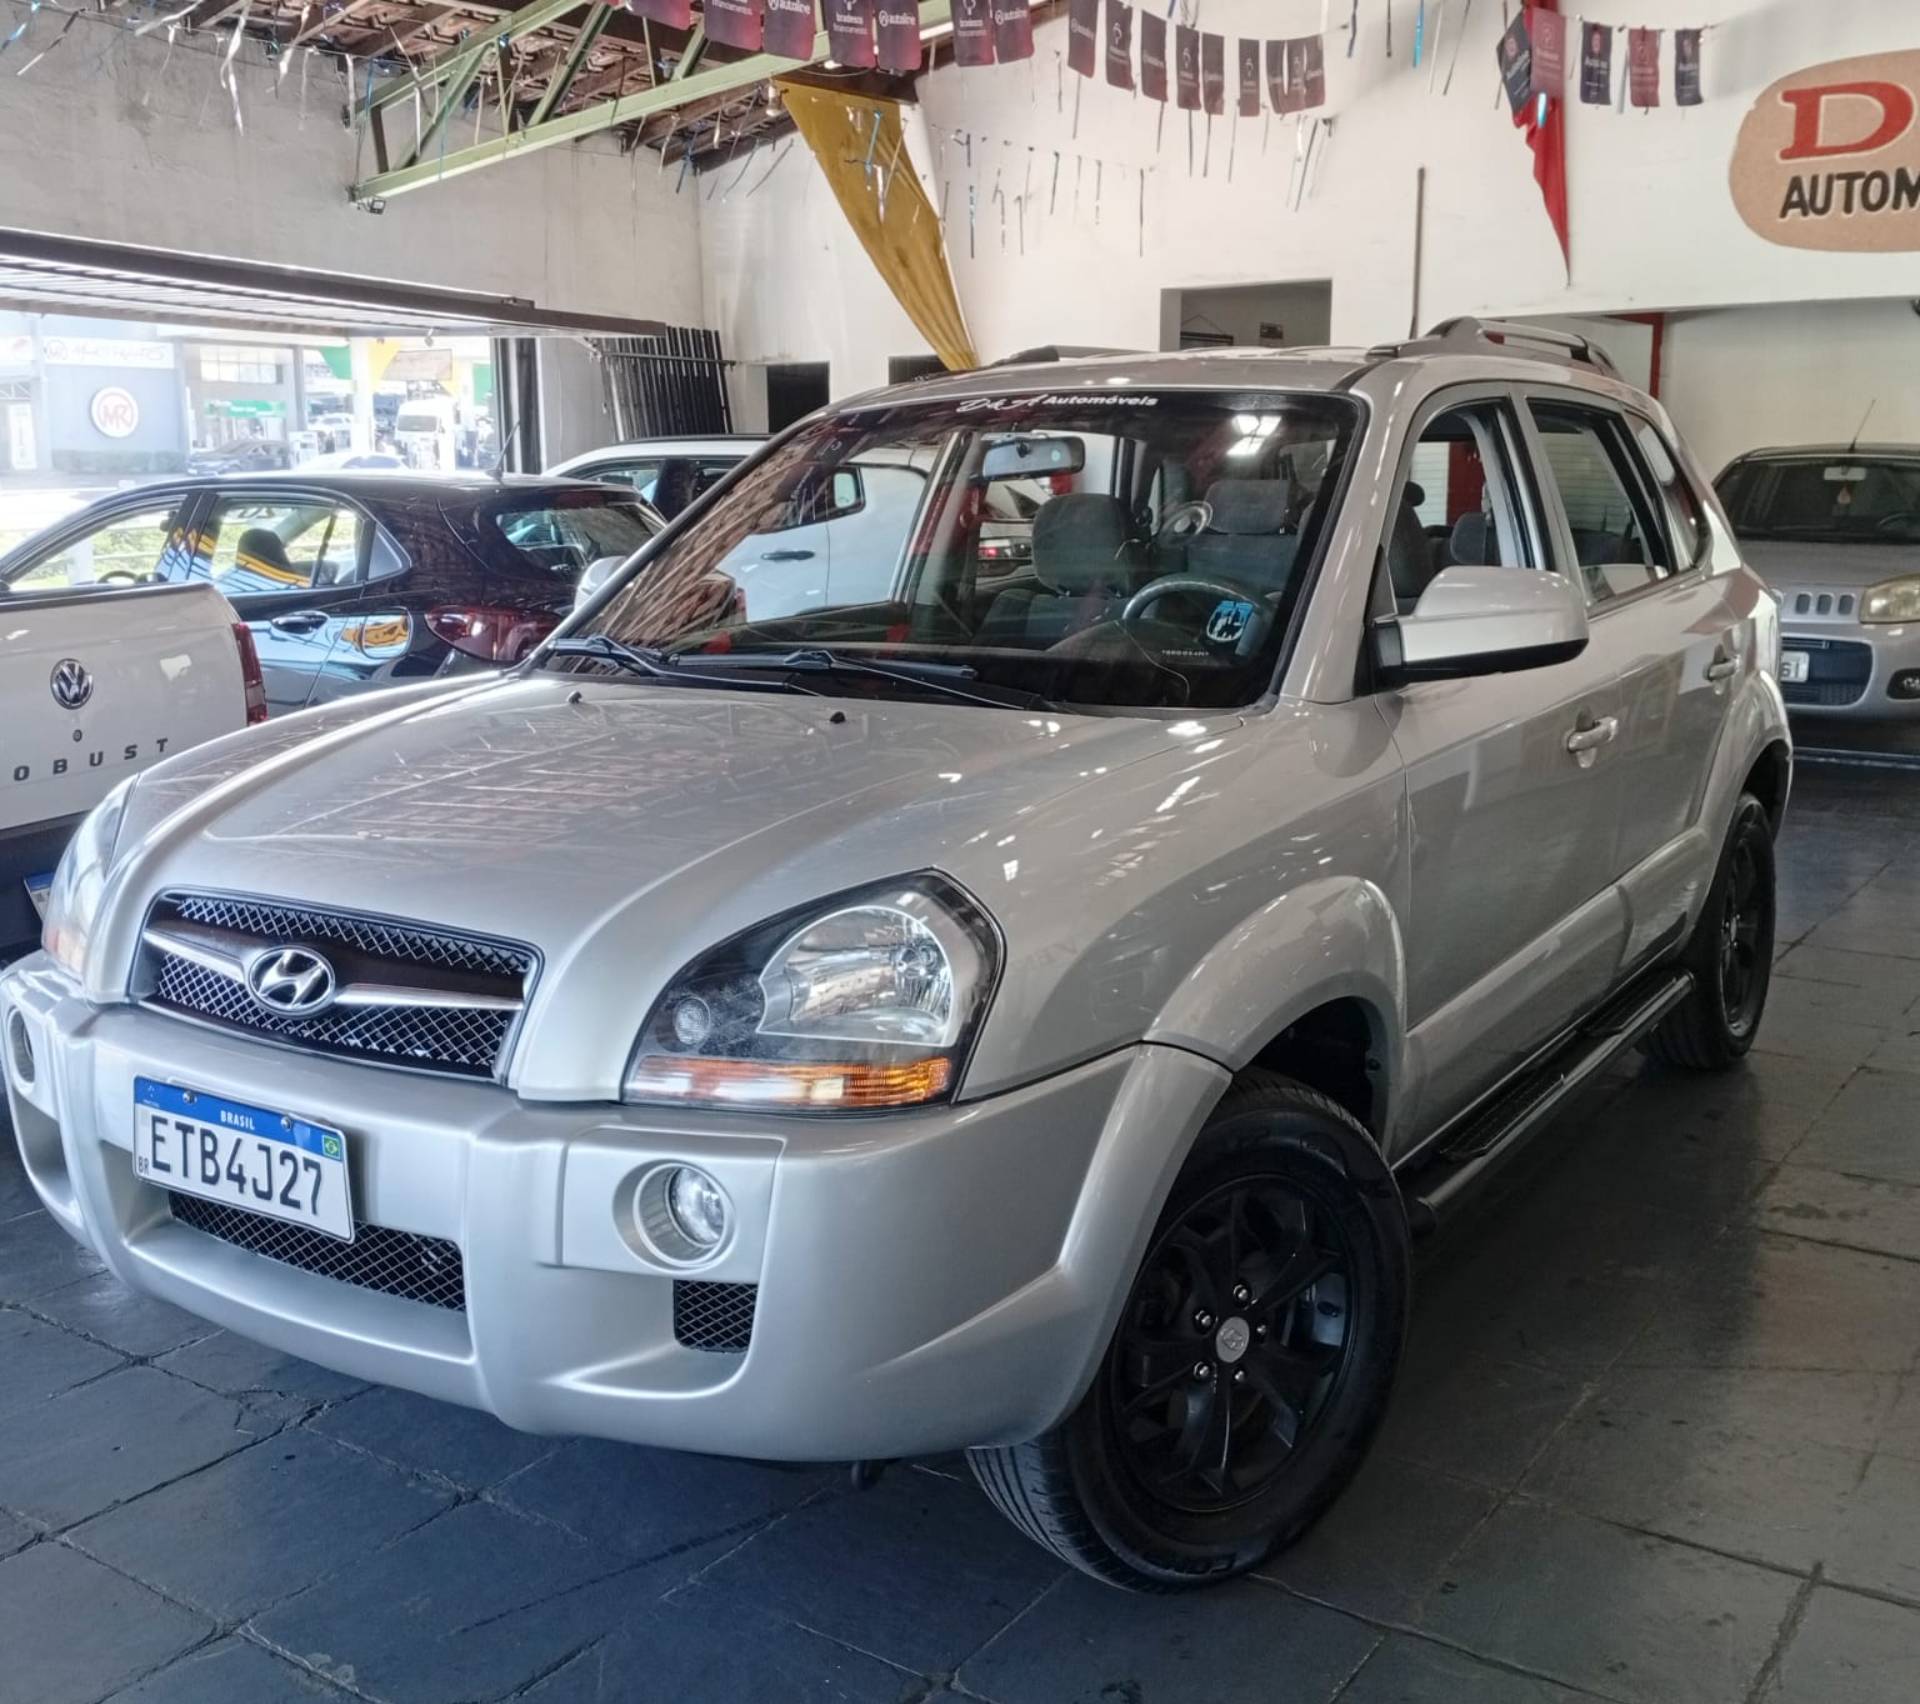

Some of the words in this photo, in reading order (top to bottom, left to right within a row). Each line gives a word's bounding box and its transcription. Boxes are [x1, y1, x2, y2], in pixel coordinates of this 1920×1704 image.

[1779, 167, 1920, 219] AUTOM
[1044, 395, 1159, 406] Automóveis
[13, 738, 168, 781] OBUST
[220, 1110, 255, 1130] BRASIL
[138, 1156, 150, 1175] BR
[151, 1115, 322, 1216] ETB4J27
